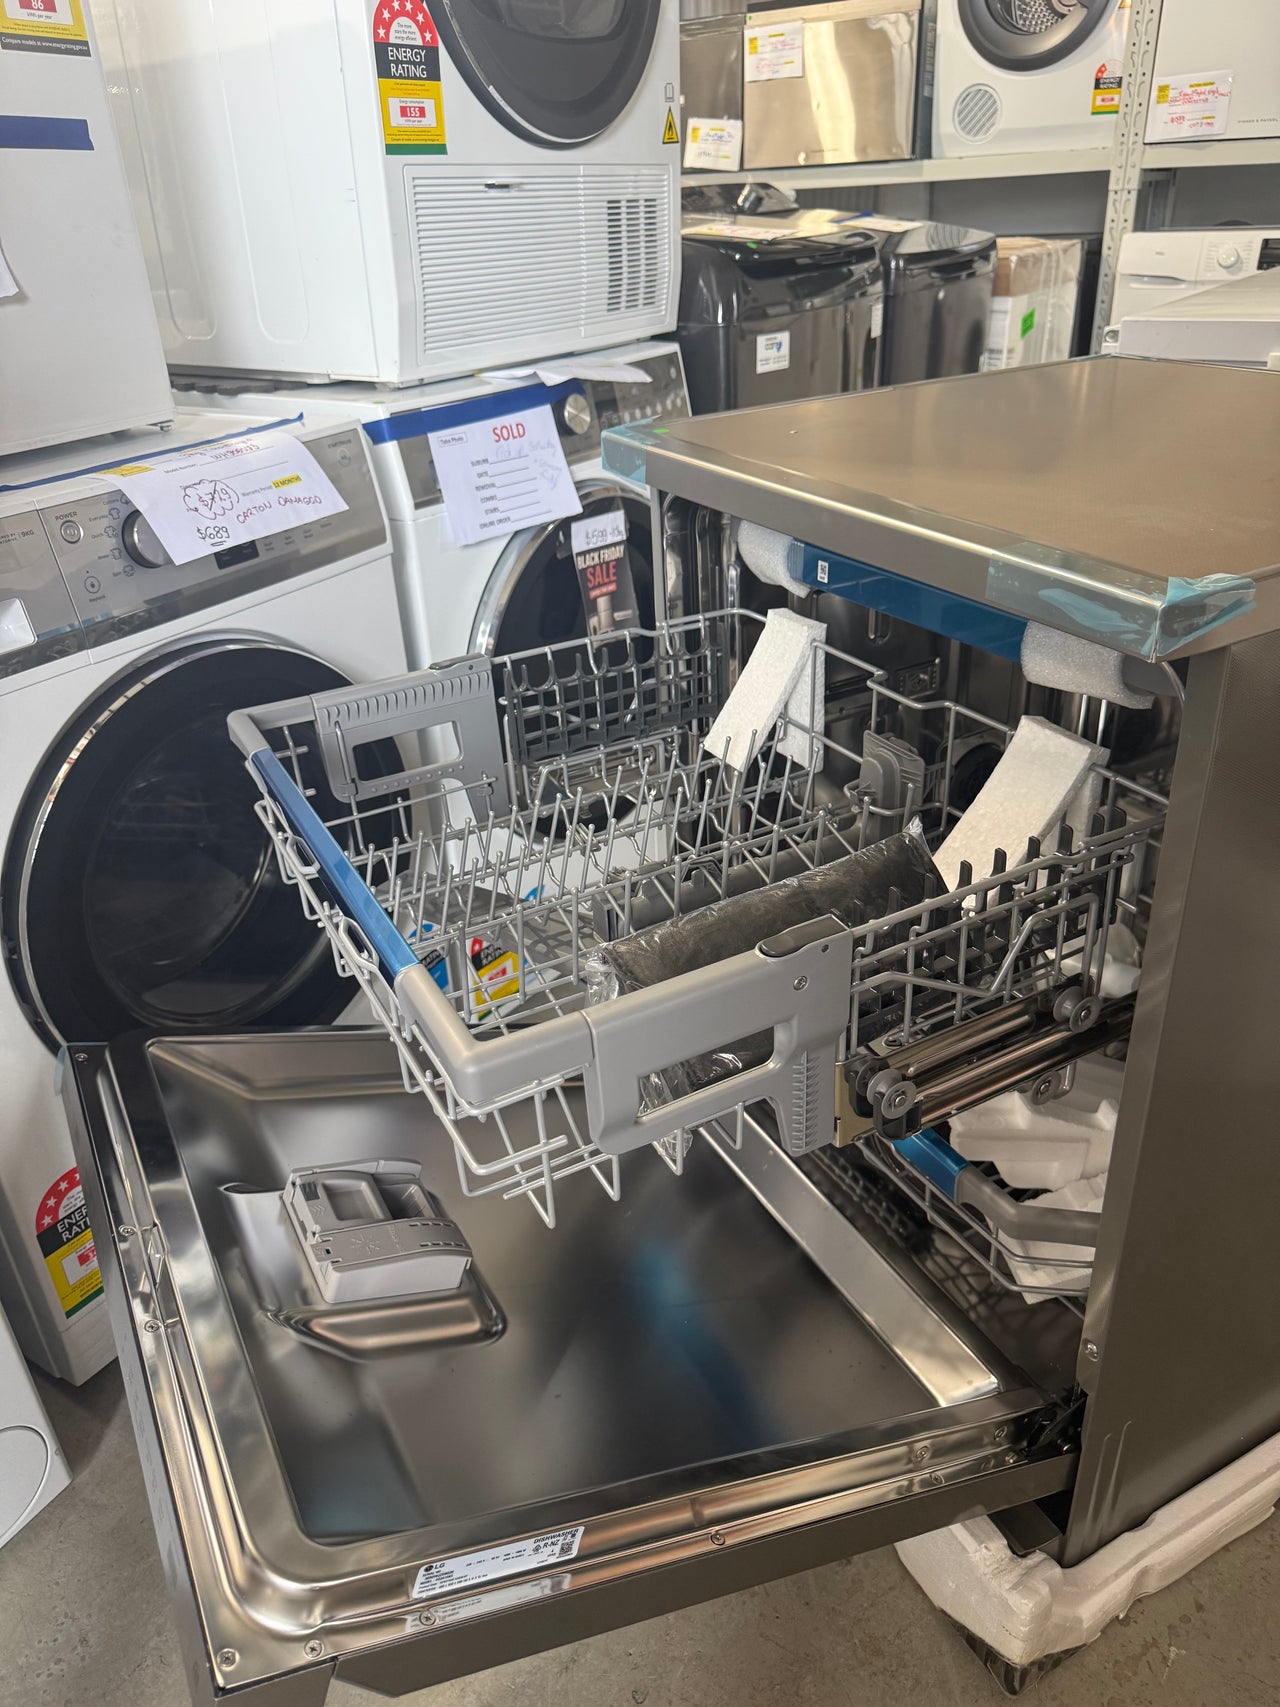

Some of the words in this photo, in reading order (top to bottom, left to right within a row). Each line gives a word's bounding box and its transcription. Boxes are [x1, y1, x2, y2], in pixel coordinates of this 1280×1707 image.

[387, 47, 426, 62] ENERGY
[390, 63, 427, 77] RATING
[407, 107, 420, 117] 155
[492, 422, 526, 443] SOLD
[54, 511, 78, 521] POWER
[236, 501, 273, 524] CARTON
[21, 529, 35, 538] 9KG
[197, 525, 231, 541] $689
[576, 551, 600, 570] BLACK
[600, 544, 625, 563] FRIDAY
[586, 560, 617, 588] SALE
[533, 1528, 580, 1544] DISHWASHER
[542, 1539, 560, 1549] R-NZ
[434, 1562, 446, 1570] LG
